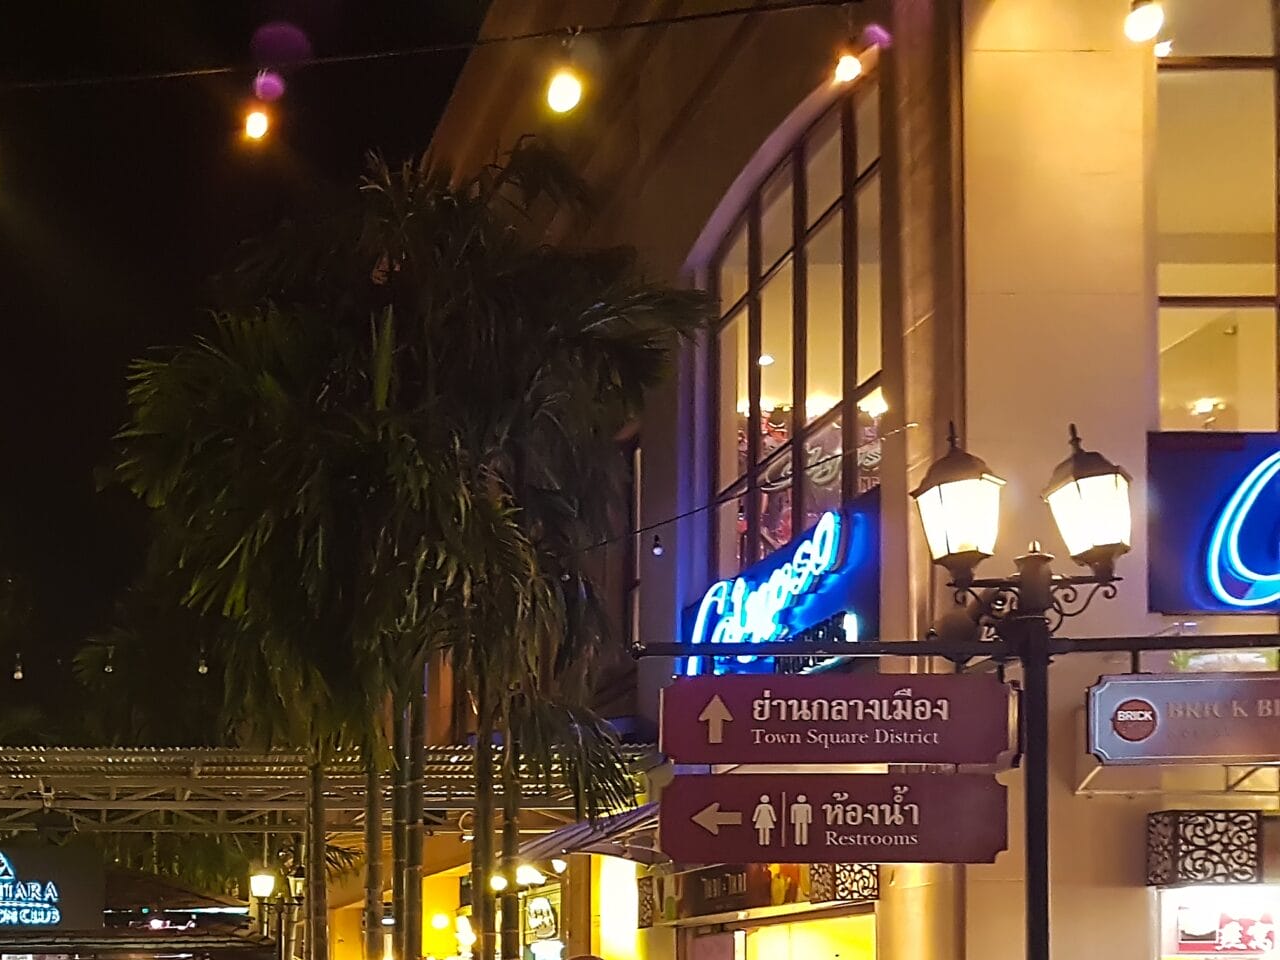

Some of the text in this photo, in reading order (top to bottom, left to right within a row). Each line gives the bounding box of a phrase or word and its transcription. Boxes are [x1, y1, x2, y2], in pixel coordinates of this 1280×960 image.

[753, 688, 949, 721] ย่านกลางเมือง
[1167, 700, 1248, 718] BRICK
[1117, 710, 1153, 721] BRICK
[751, 729, 939, 748] Town Square District
[822, 786, 919, 825] ห้องน้ำ
[825, 831, 918, 845] Restrooms
[20, 908, 60, 924] CLUB
